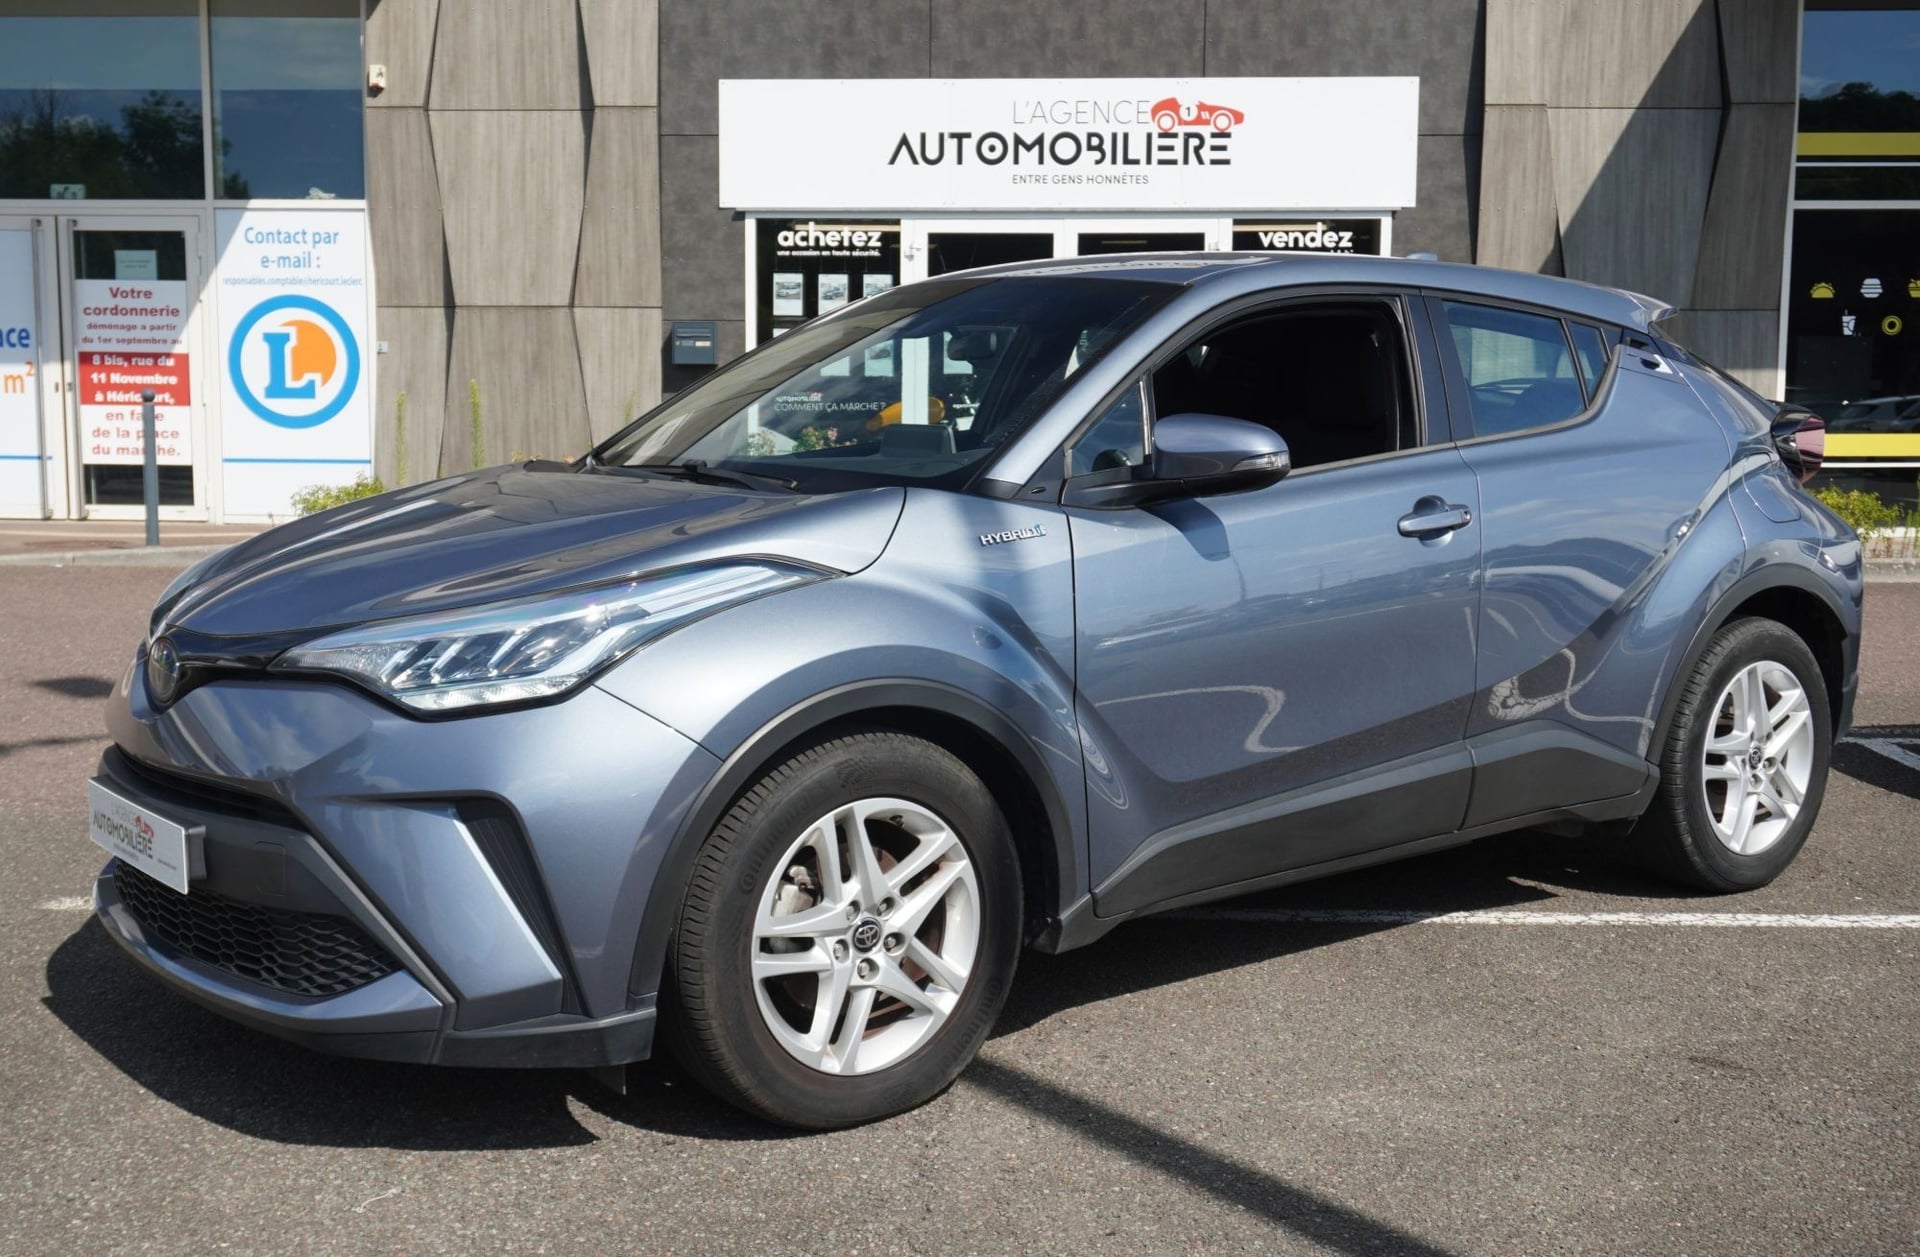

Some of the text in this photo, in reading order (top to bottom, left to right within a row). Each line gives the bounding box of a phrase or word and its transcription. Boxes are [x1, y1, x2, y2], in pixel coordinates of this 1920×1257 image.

[1012, 100, 1150, 124] L'AGENCE
[1185, 106, 1191, 117] 1
[1012, 172, 1149, 185] ENTRE GENS HONNÊTES
[244, 226, 339, 249] Contact par
[777, 221, 882, 247] achetez
[1258, 221, 1354, 248] vendez
[260, 250, 312, 268] e-mail
[109, 287, 153, 299] Votre
[83, 304, 180, 317] cordonnerie
[149, 322, 177, 331] partir
[0, 327, 31, 348] ce
[81, 336, 94, 344] du
[97, 336, 112, 344] 1er
[115, 336, 168, 345] septembre
[92, 354, 175, 367] 8 bis, rue du
[90, 372, 178, 385] 11 Novembre
[94, 391, 104, 402] à
[774, 403, 824, 412] COMMENT
[825, 403, 838, 413] ÇA
[839, 402, 879, 411] MARCHE
[105, 409, 164, 421] en fae
[92, 426, 179, 440] de la pace
[92, 444, 110, 455] du
[979, 526, 1037, 546] HYBRID
